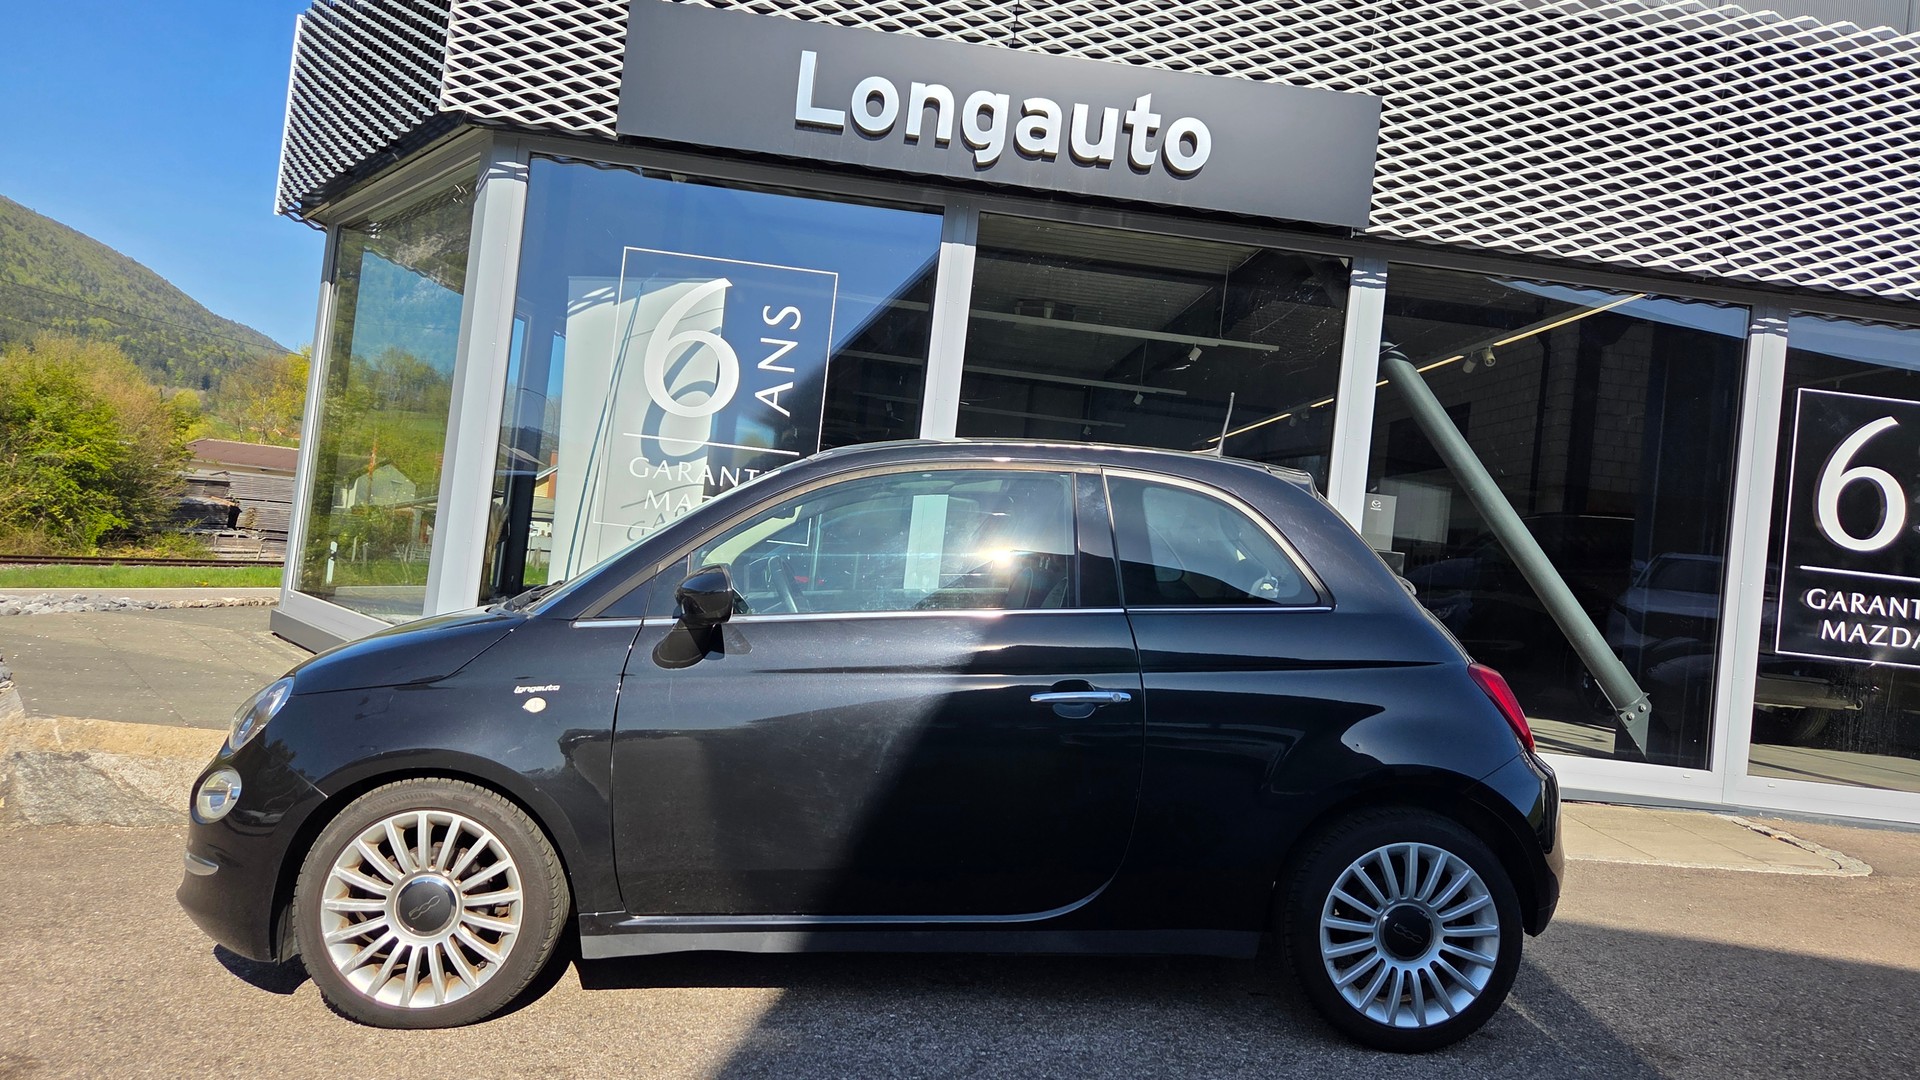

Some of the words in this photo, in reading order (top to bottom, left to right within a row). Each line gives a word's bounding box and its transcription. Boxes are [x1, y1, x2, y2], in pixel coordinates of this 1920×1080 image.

[795, 50, 1213, 177] Longauto
[644, 278, 740, 418] 6
[754, 305, 802, 418] ANS
[629, 456, 771, 488] GARANT
[1817, 415, 1906, 552] 6
